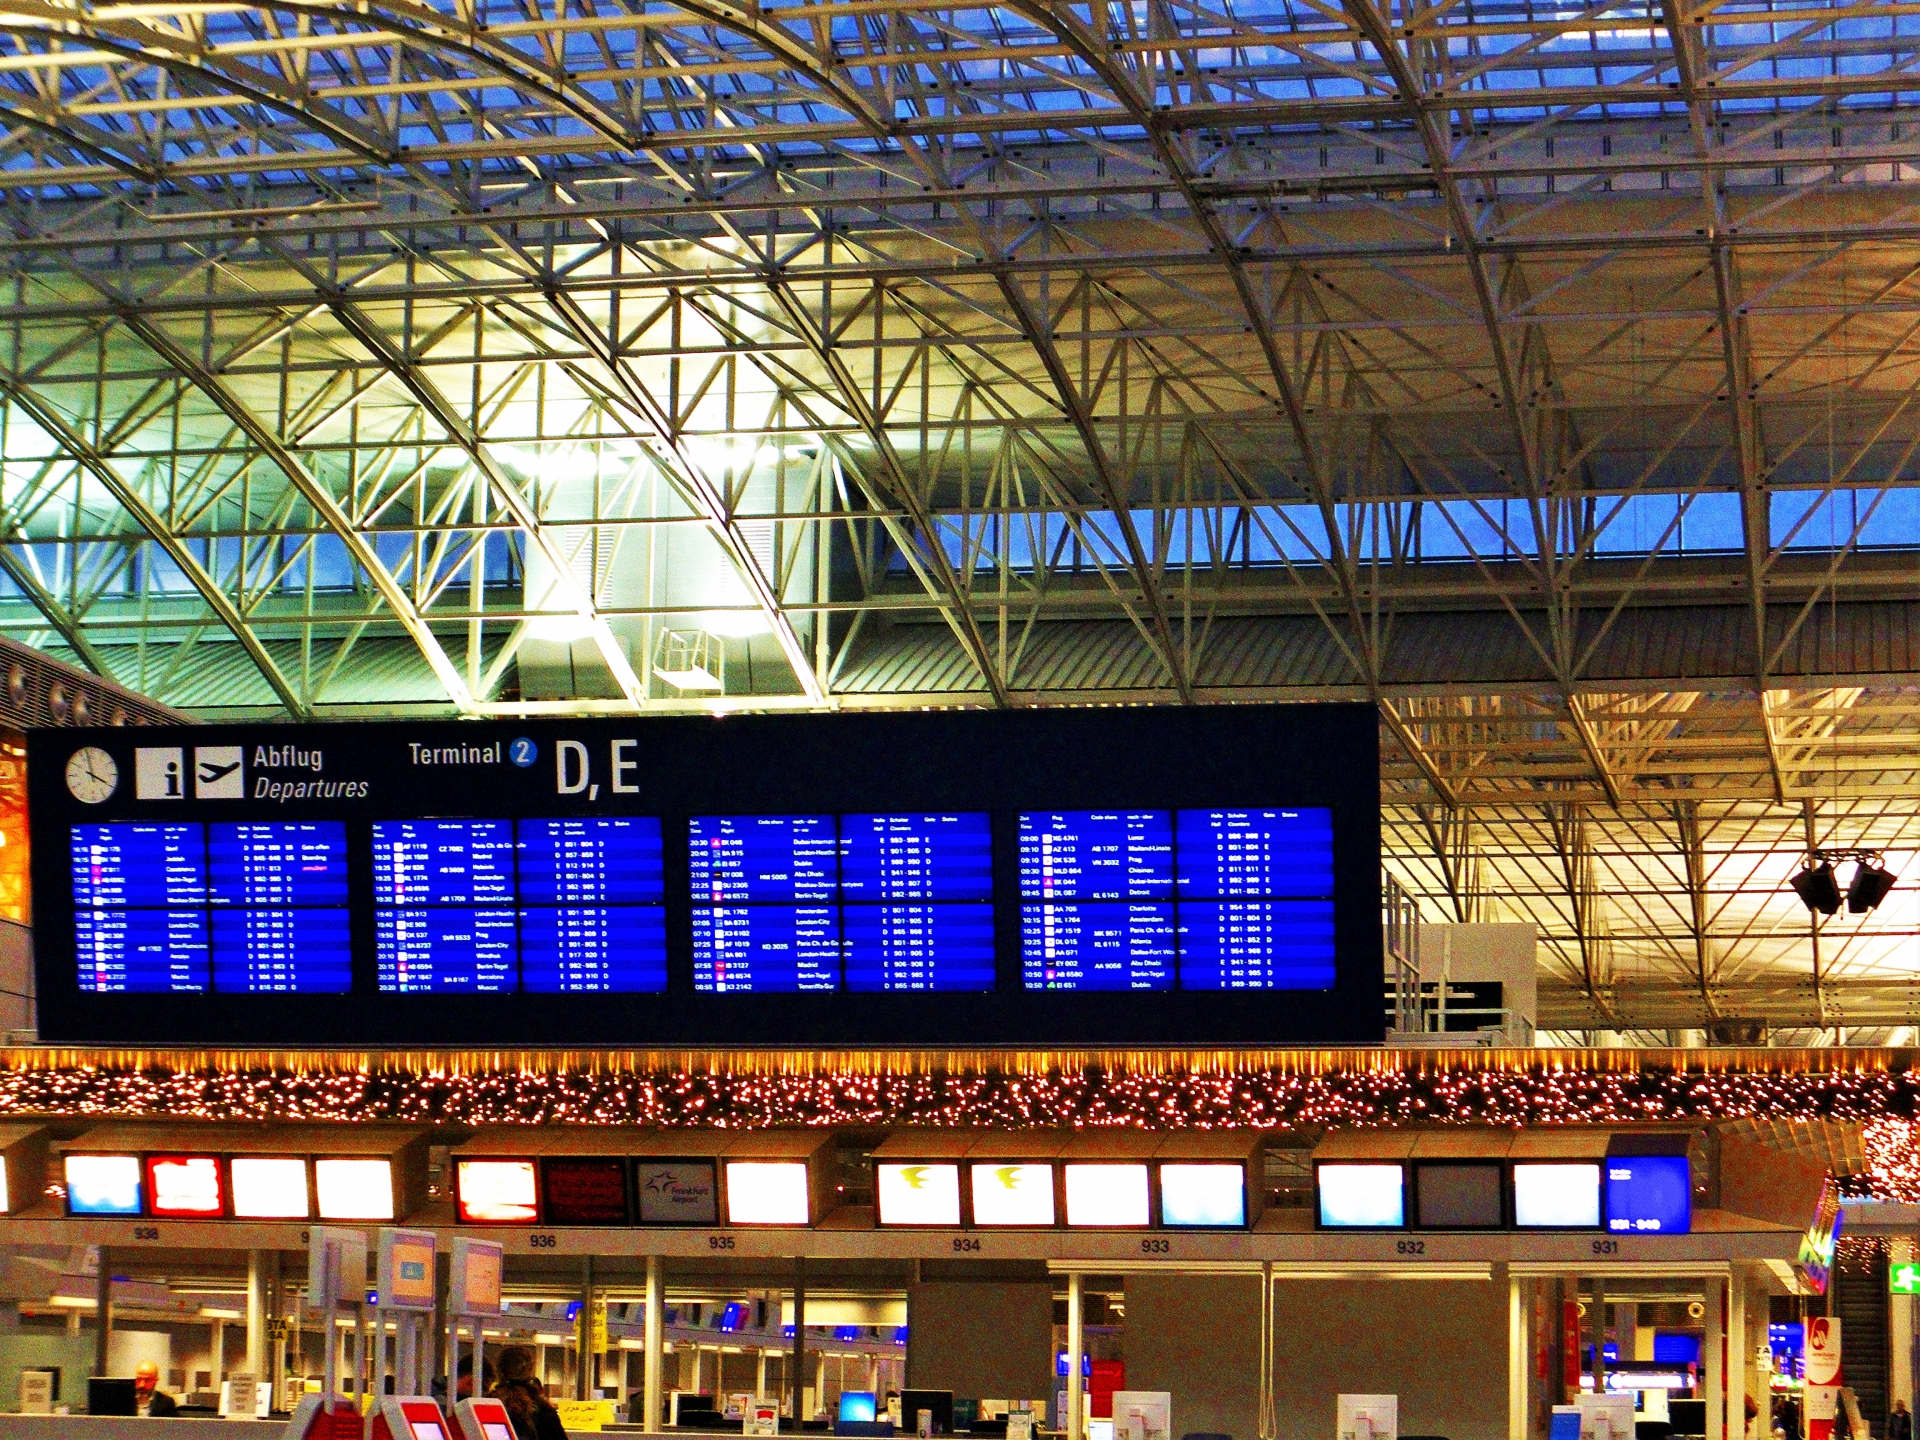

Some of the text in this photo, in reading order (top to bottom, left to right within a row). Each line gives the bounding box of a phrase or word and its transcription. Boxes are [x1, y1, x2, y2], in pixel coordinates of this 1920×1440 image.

[254, 745, 322, 770] Abflug
[409, 742, 500, 765] Terminal
[516, 742, 530, 762] 2
[254, 776, 368, 803] Departures
[530, 1235, 556, 1247] 936
[710, 1237, 735, 1249] 935
[953, 1239, 980, 1252] 934
[1142, 1239, 1169, 1253] 933
[1397, 1240, 1425, 1254] 932
[1592, 1241, 1617, 1253] 931
